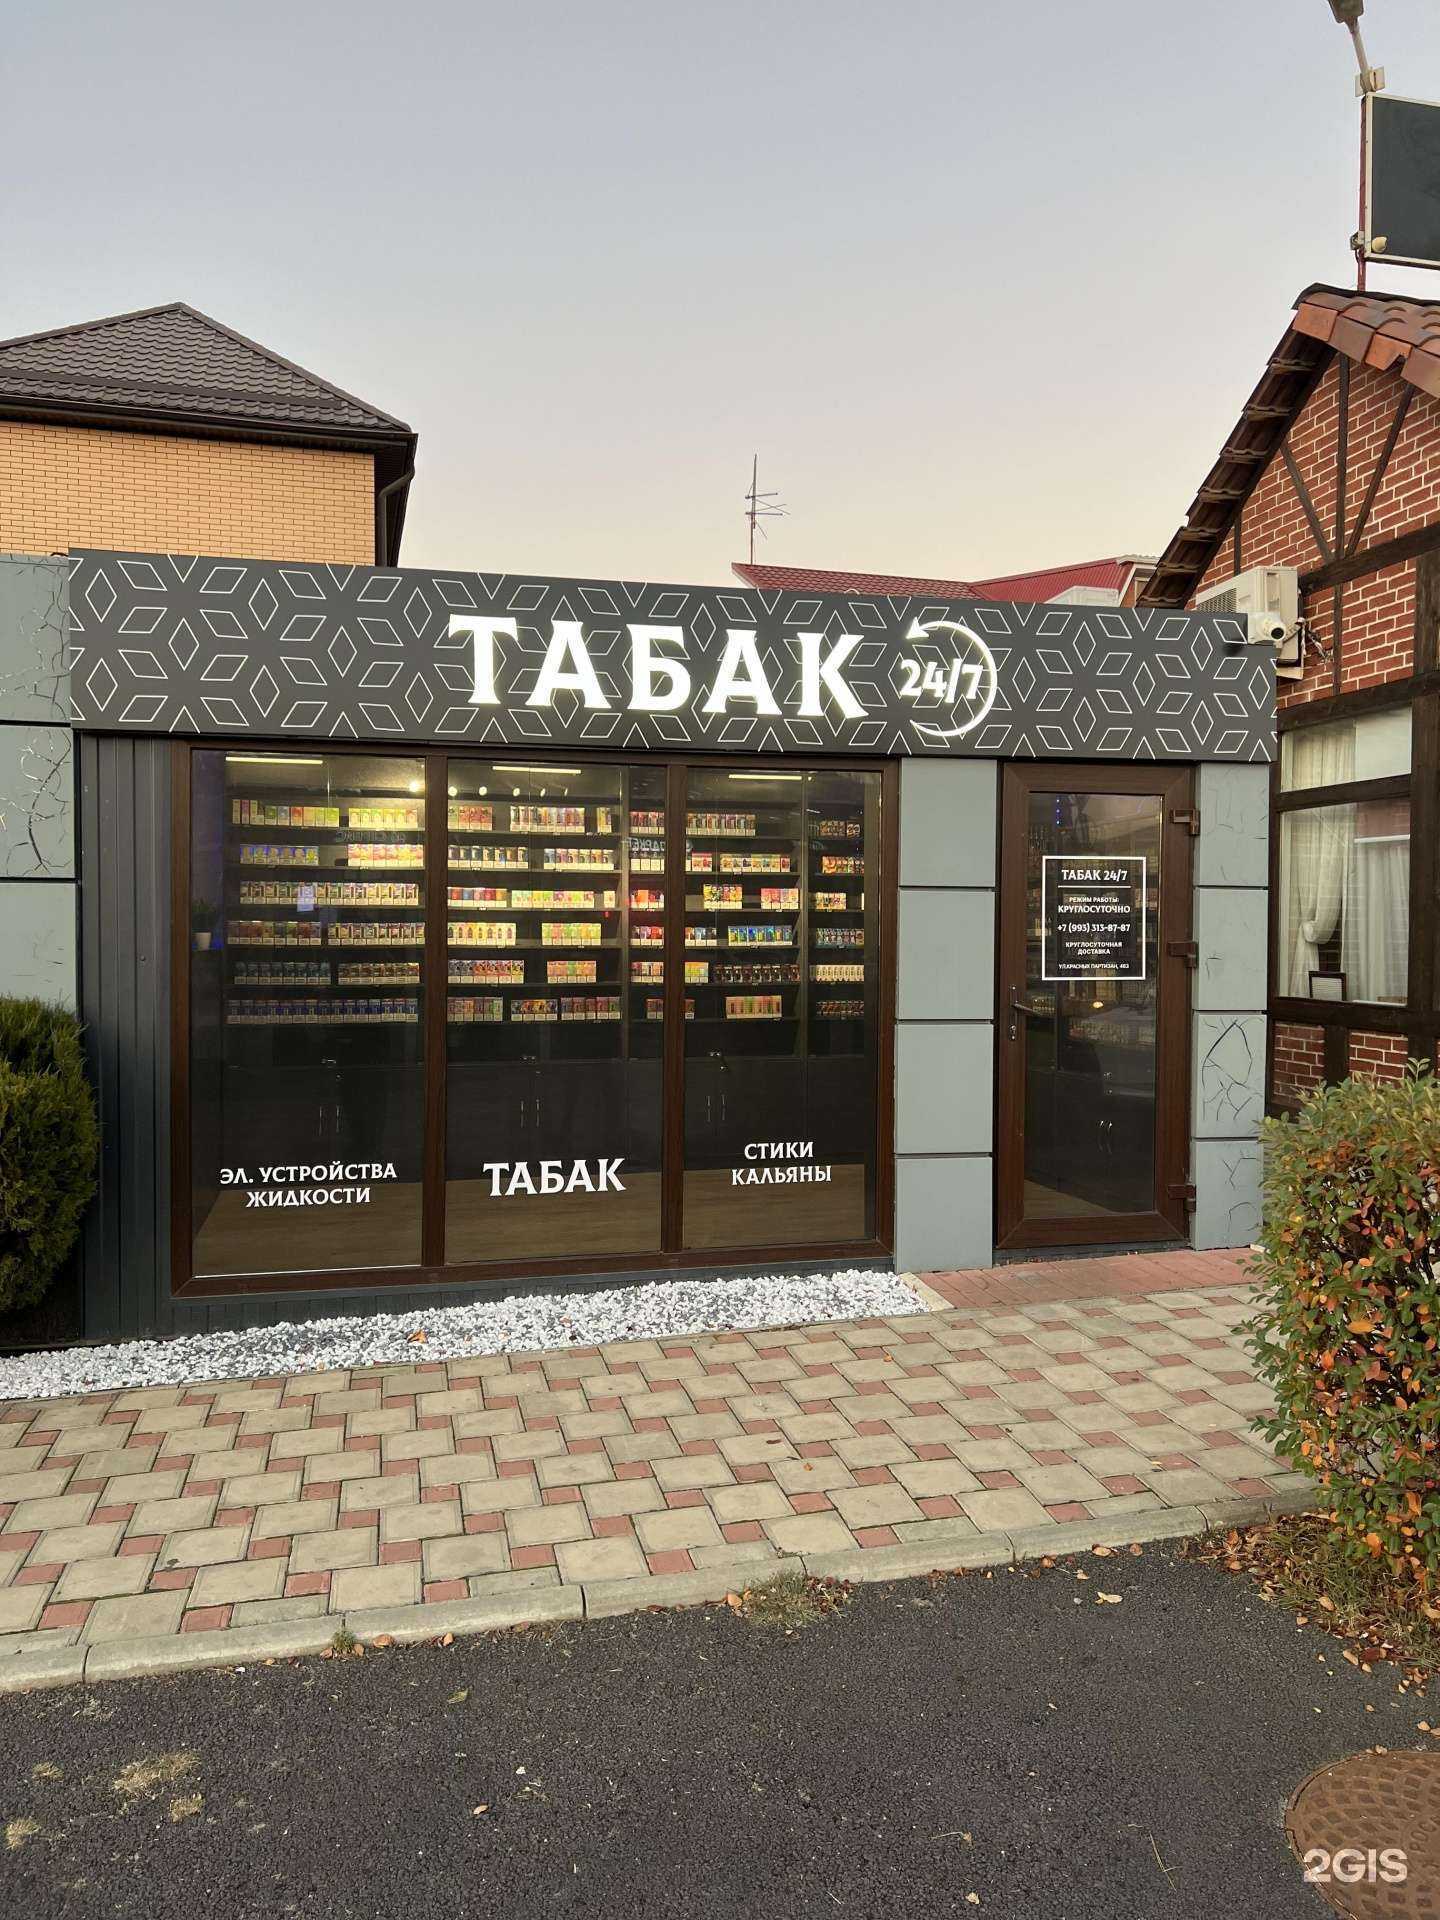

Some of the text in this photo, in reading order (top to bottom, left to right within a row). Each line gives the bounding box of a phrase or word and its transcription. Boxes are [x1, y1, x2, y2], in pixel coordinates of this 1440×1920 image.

[448, 613, 870, 719] ТАБАК
[900, 658, 984, 704] 24/7
[1061, 869, 1128, 882] ТАБАК 24/7
[1058, 905, 1131, 914] КРУГЛОСУТОЧНО
[1057, 924, 1067, 932] +7
[744, 1141, 814, 1160] СТИКИ
[219, 1160, 398, 1185] ЭЛ. УСТРОЙСТВА
[482, 1157, 627, 1197] ТАБАК
[731, 1165, 832, 1186] КАЛЬЯНЫ
[246, 1187, 371, 1208] ЖИДКОСТИ
